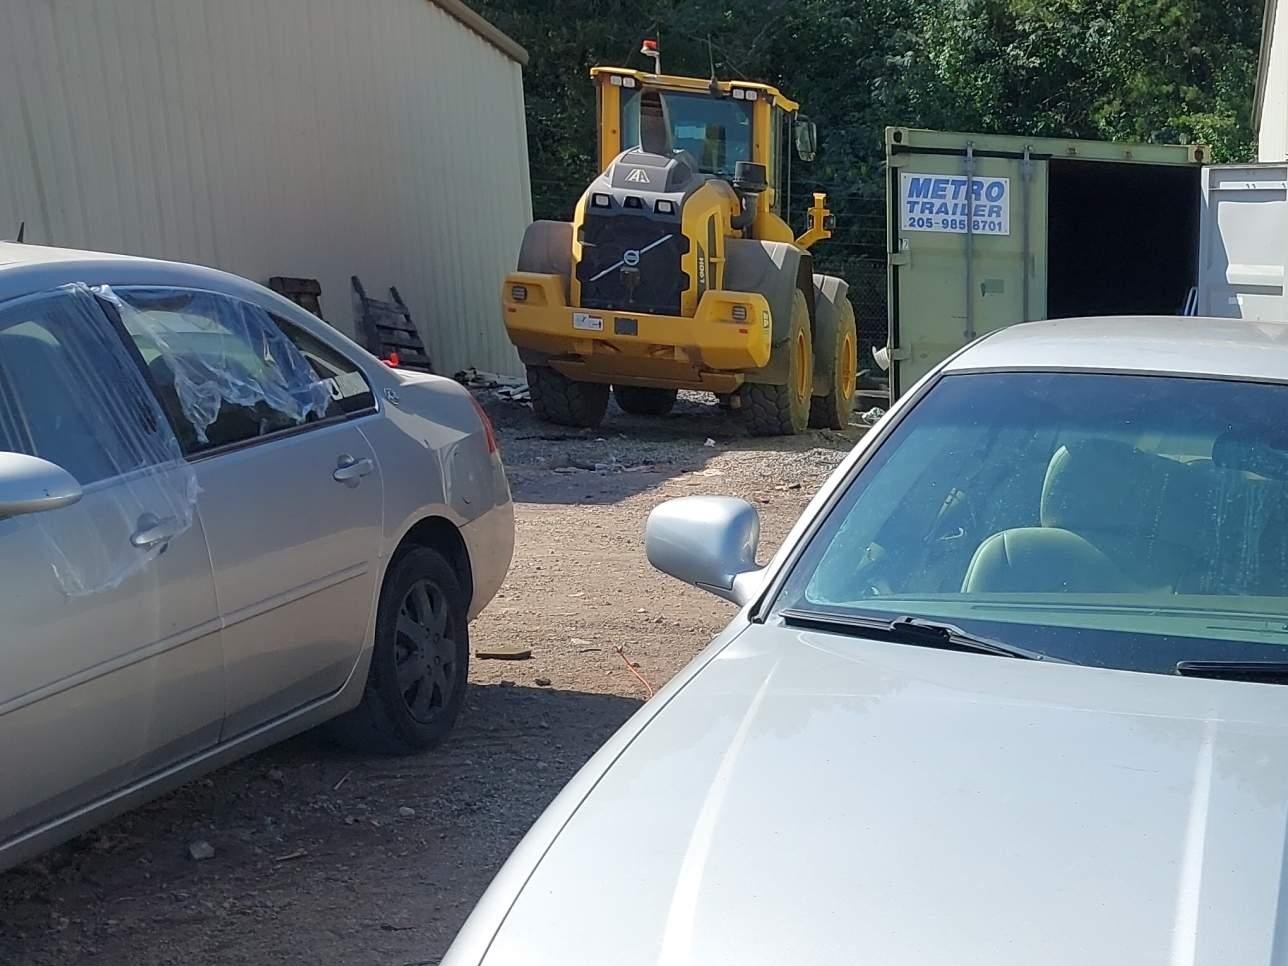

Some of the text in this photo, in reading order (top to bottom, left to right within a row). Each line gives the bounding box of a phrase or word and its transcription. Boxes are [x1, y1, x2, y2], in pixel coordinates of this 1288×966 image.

[907, 177, 1005, 203] METRO
[906, 200, 1003, 218] TRAILER
[908, 217, 1002, 232] 205-9858701
